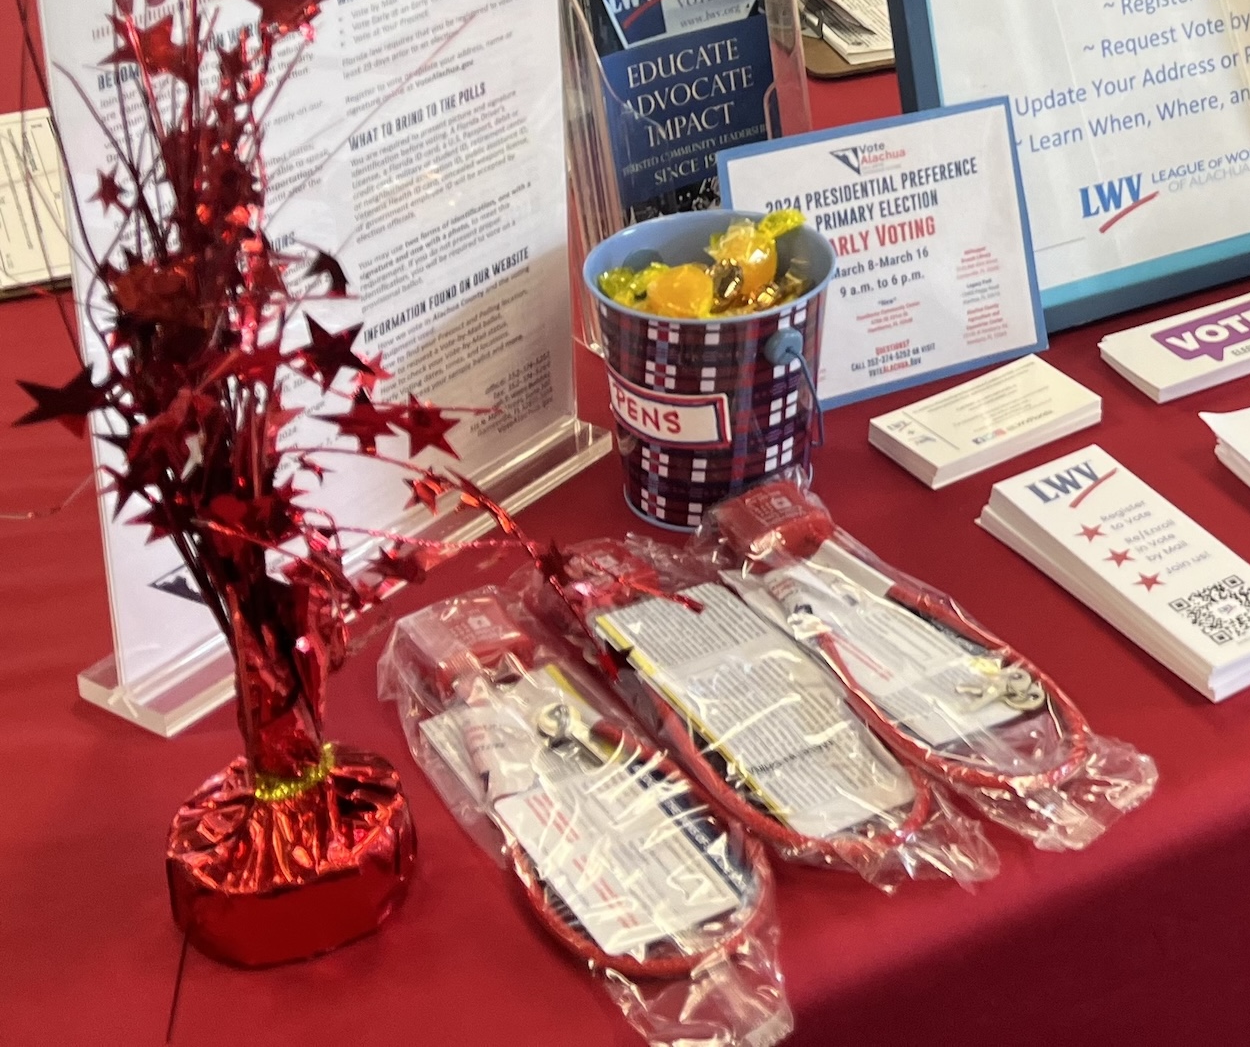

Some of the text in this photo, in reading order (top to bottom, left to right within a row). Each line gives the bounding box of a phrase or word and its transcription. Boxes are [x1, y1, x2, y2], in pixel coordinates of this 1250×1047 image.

[1101, 26, 1177, 60] Request
[1182, 15, 1224, 42] Vote
[627, 38, 739, 88] EDUCATE
[396, 82, 485, 133] BRING POLLS
[622, 65, 754, 120] ADVOCATE
[1015, 85, 1087, 120] Update
[1091, 74, 1138, 103] Your
[1142, 58, 1215, 90] Address
[645, 101, 734, 147] IMPACT
[1029, 124, 1083, 154] Learn
[1088, 110, 1152, 140] When,
[1157, 95, 1226, 128] Where,
[858, 141, 885, 154] Vote
[860, 148, 906, 165] Alachua
[654, 157, 699, 185] SINCE
[805, 156, 978, 212] PRESIDENTIAL PREFERENCE
[815, 189, 938, 232] PRIMARY ELECTION
[1080, 174, 1144, 220] LWV
[876, 215, 935, 248] VOTING
[363, 247, 529, 344] INFORMATION FOUND WEBSITE
[850, 270, 924, 295] a.m. p.m.
[613, 384, 681, 435] PENS
[1025, 460, 1100, 504] LWV
